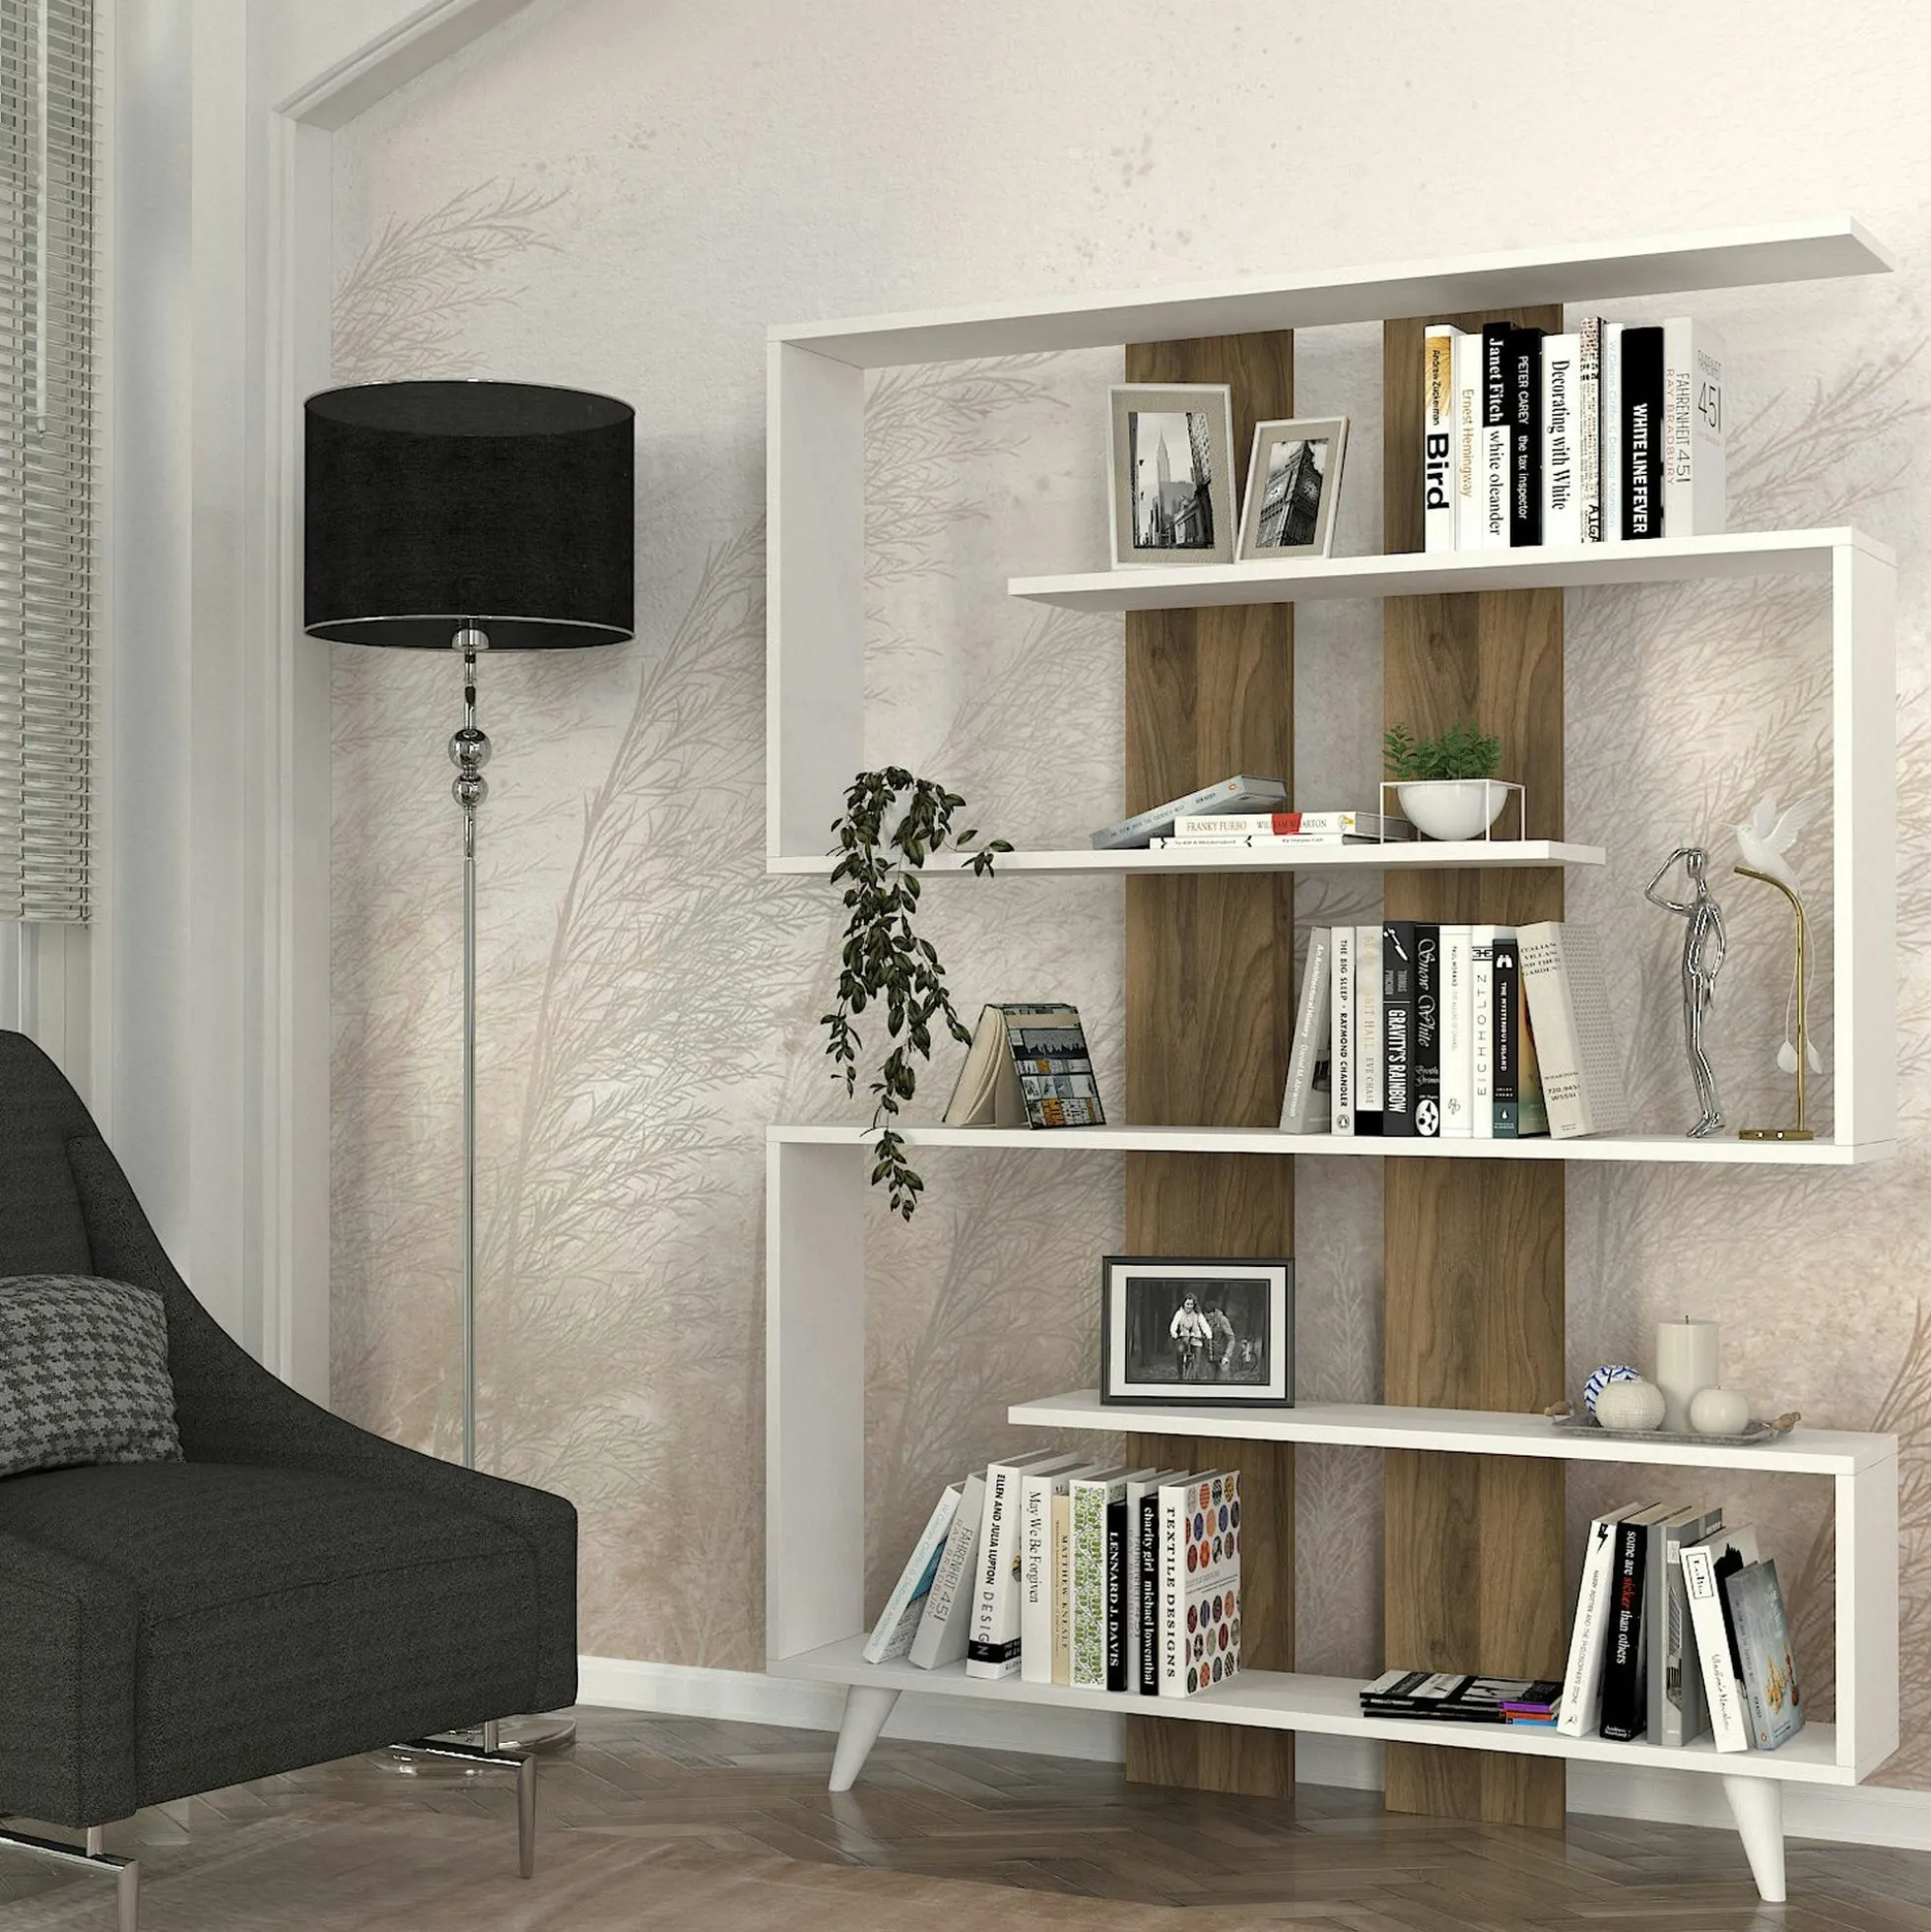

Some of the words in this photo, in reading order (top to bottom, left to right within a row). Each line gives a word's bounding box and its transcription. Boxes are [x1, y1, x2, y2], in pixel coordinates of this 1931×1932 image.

[1489, 338, 1503, 379] Janet
[1517, 356, 1529, 387] PETER
[1548, 361, 1570, 433] Decorating
[1666, 368, 1675, 397] RAY
[1462, 389, 1474, 425] Ernest
[1489, 384, 1503, 422] Fitch
[1517, 391, 1529, 425] CAREY
[1676, 373, 1690, 446] FAHRENHEIT
[1517, 435, 1529, 451] the
[1632, 403, 1647, 449] WHITE
[1458, 428, 1474, 498] Hemingway
[1490, 431, 1503, 470] white
[1517, 455, 1527, 470] tax
[1552, 437, 1569, 465] with
[1666, 404, 1675, 486] BRADBURY
[1427, 433, 1449, 509] Bird
[1632, 452, 1647, 486] LINE
[1676, 449, 1691, 484] 451
[1490, 474, 1503, 535] oleander
[1516, 473, 1529, 519] inspector
[1551, 470, 1569, 510] White
[1632, 487, 1647, 533] FEVER
[1186, 822, 1217, 833] FRANKY
[1220, 820, 1246, 832] FURBO
[1256, 819, 1288, 830] WILAM
[1289, 819, 1327, 830] WARTON
[1316, 944, 1324, 957] An
[1417, 938, 1435, 990] Snow
[1303, 957, 1323, 1009] Architectural
[1365, 1021, 1375, 1049] HALL
[1387, 1009, 1406, 1062] GRAVITY'S
[1417, 995, 1435, 1047] White
[1477, 974, 1487, 1097] EICHHOLTZ
[1365, 1057, 1375, 1074] EVE
[1365, 1076, 1375, 1103] CHASE
[1388, 1064, 1407, 1113] RAINBOW
[994, 1474, 1006, 1499] ELLEN
[1026, 1492, 1040, 1514] May
[992, 1500, 1002, 1522] AND
[1030, 1519, 1040, 1537] We
[1144, 1506, 1155, 1549] charity
[950, 1518, 963, 1543] RAY
[989, 1523, 999, 1548] JULIA
[1030, 1539, 1040, 1553] Be
[1166, 1506, 1175, 1587] TEXTILE
[1625, 1531, 1636, 1558] some
[945, 1526, 973, 1590] FAHRENHEIT
[985, 1549, 997, 1585] LUPTON
[1109, 1532, 1118, 1603] LENNARD
[1143, 1551, 1155, 1572] girl
[1624, 1560, 1635, 1575] are
[925, 1549, 953, 1618] BRADBURY
[1026, 1556, 1040, 1604] Forgiven
[1621, 1576, 1633, 1609] sicker
[933, 1591, 951, 1622] 451
[1109, 1606, 1118, 1618] J.
[1144, 1580, 1155, 1626] michael
[1620, 1610, 1632, 1632] than
[977, 1591, 993, 1656] DESIGN
[1166, 1593, 1176, 1678] DESIGNS
[1109, 1621, 1118, 1667] DAVIS
[1144, 1628, 1155, 1685] lowenthal
[1617, 1633, 1630, 1664] others
